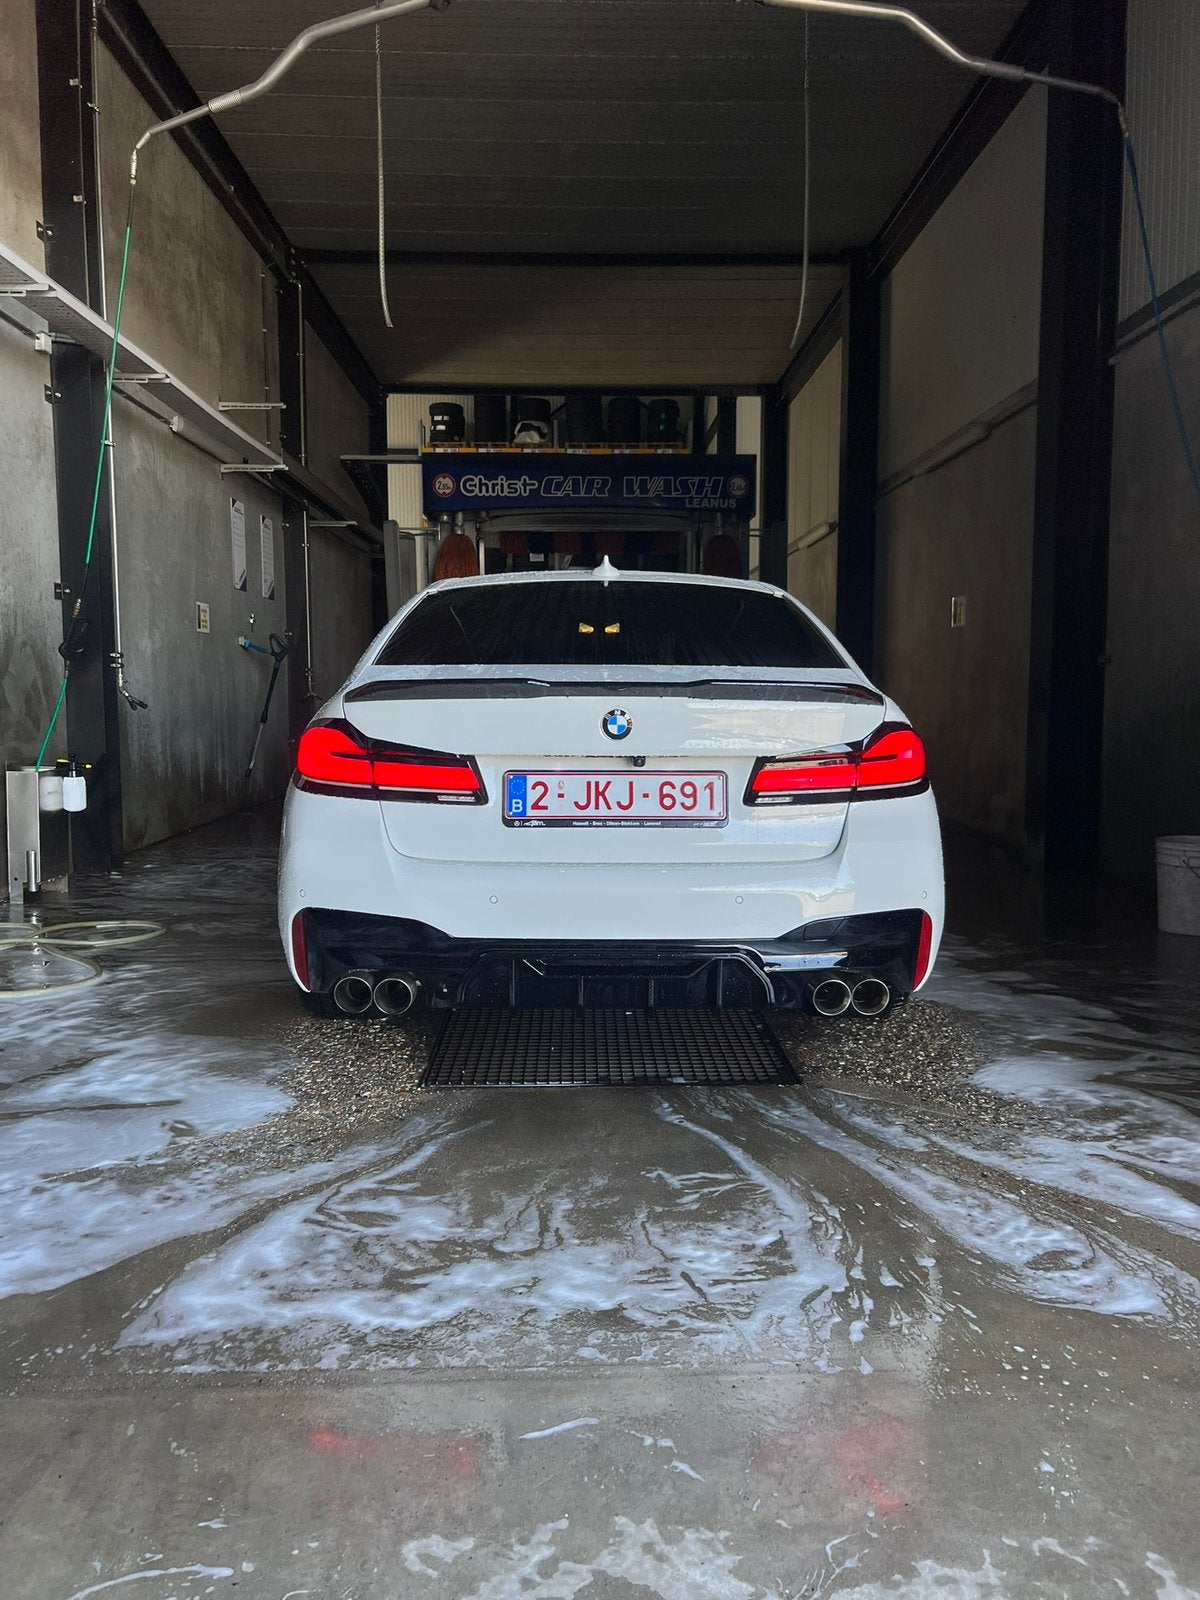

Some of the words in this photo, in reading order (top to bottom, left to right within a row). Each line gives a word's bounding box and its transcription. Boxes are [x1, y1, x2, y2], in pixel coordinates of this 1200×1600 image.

[460, 475, 538, 497] Christ
[540, 476, 612, 497] CAR
[623, 476, 724, 498] WASH
[685, 498, 737, 509] LEANUS
[511, 799, 523, 813] B
